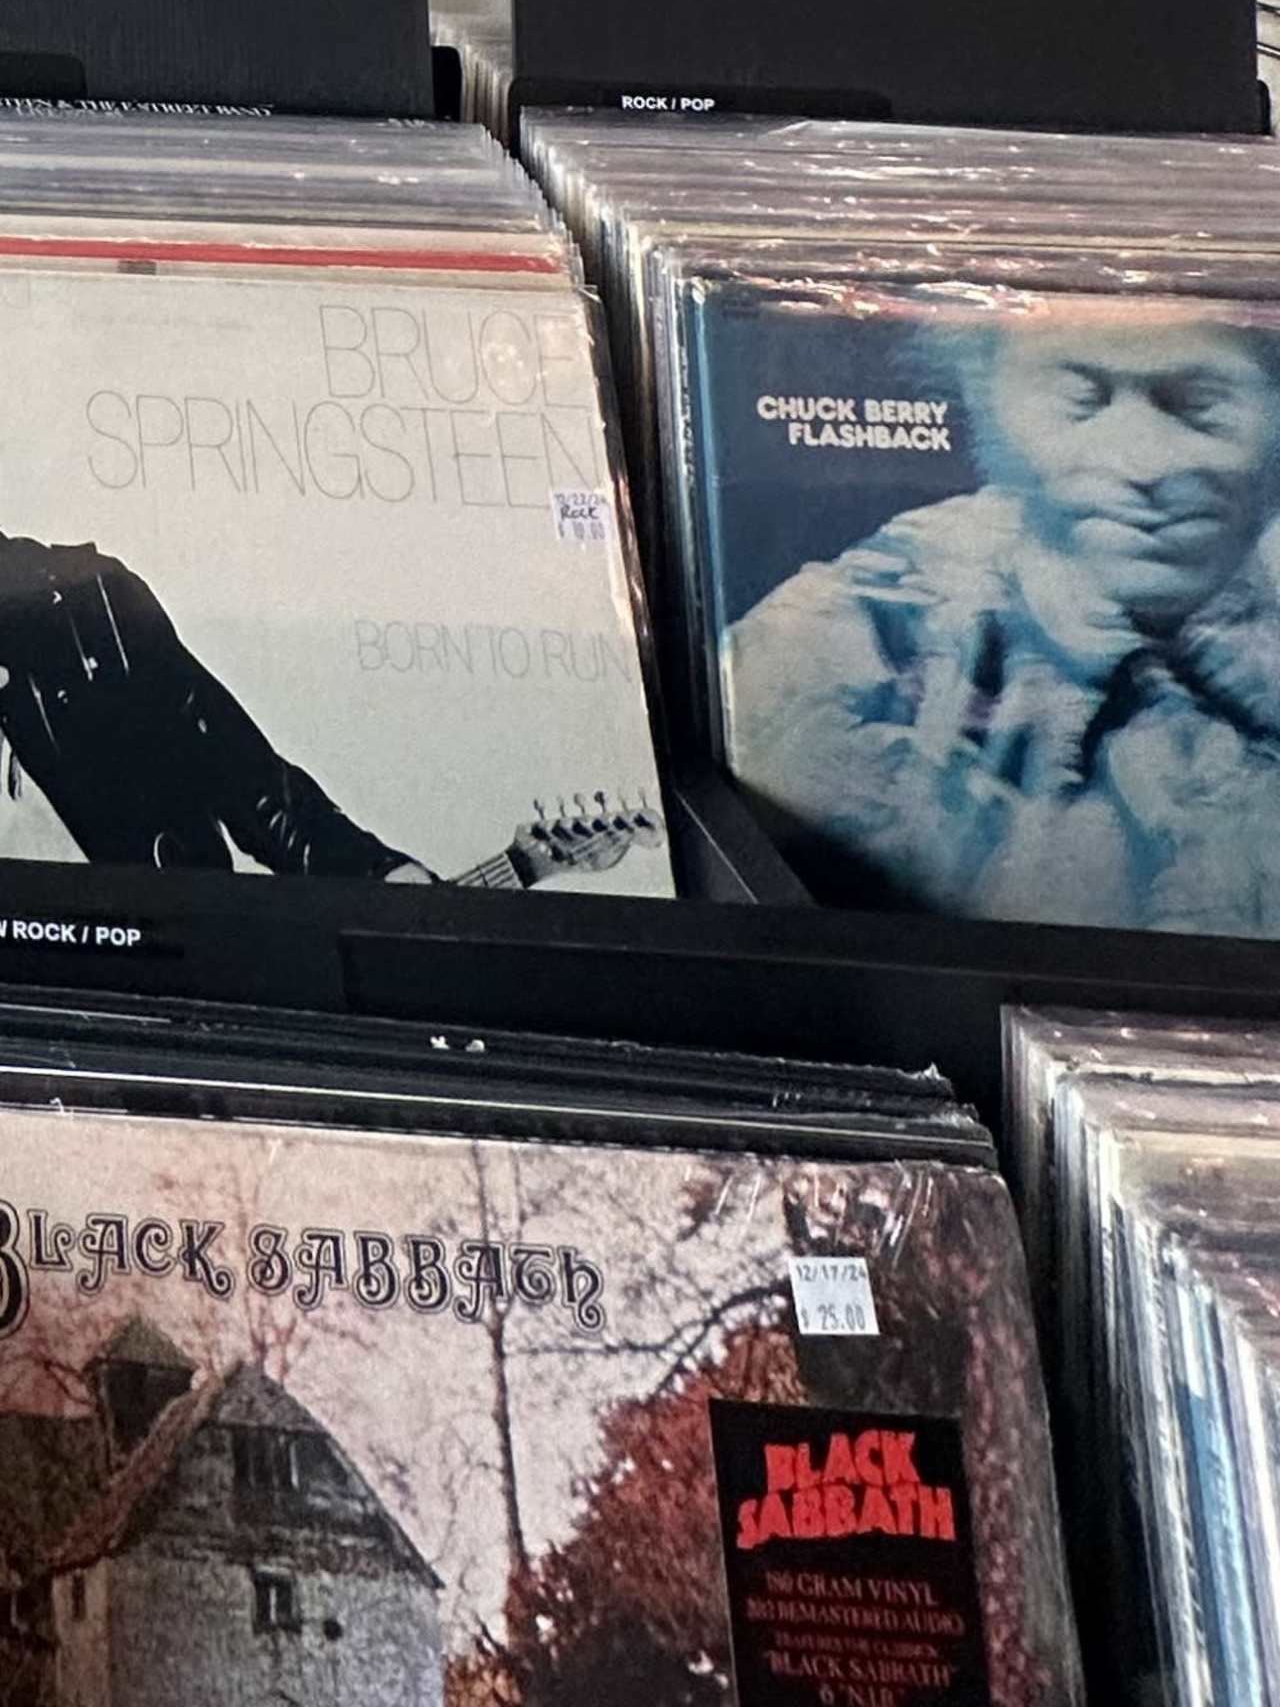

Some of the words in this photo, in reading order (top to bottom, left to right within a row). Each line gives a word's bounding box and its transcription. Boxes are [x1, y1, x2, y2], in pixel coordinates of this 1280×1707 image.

[622, 95, 668, 110] ROCK
[680, 97, 715, 111] POP
[319, 305, 593, 410] BRUCE
[756, 395, 857, 421] CHUCK
[864, 399, 948, 424] BERRY
[86, 390, 603, 509] SPRINGSTEEN
[788, 423, 951, 451] FLASHBACK
[355, 620, 474, 675] BORN
[467, 625, 531, 679] TO
[540, 628, 633, 684] RUN
[12, 920, 77, 943] ROCK
[95, 926, 141, 946] POP
[818, 1303, 866, 1331] 25.00
[765, 1429, 920, 1492] BLACK
[736, 1484, 956, 1550] SABBATH
[796, 1573, 862, 1598] GRAM
[867, 1579, 937, 1606] VINYL
[778, 1603, 899, 1628] REMASTERED
[902, 1611, 965, 1634] AUDIO
